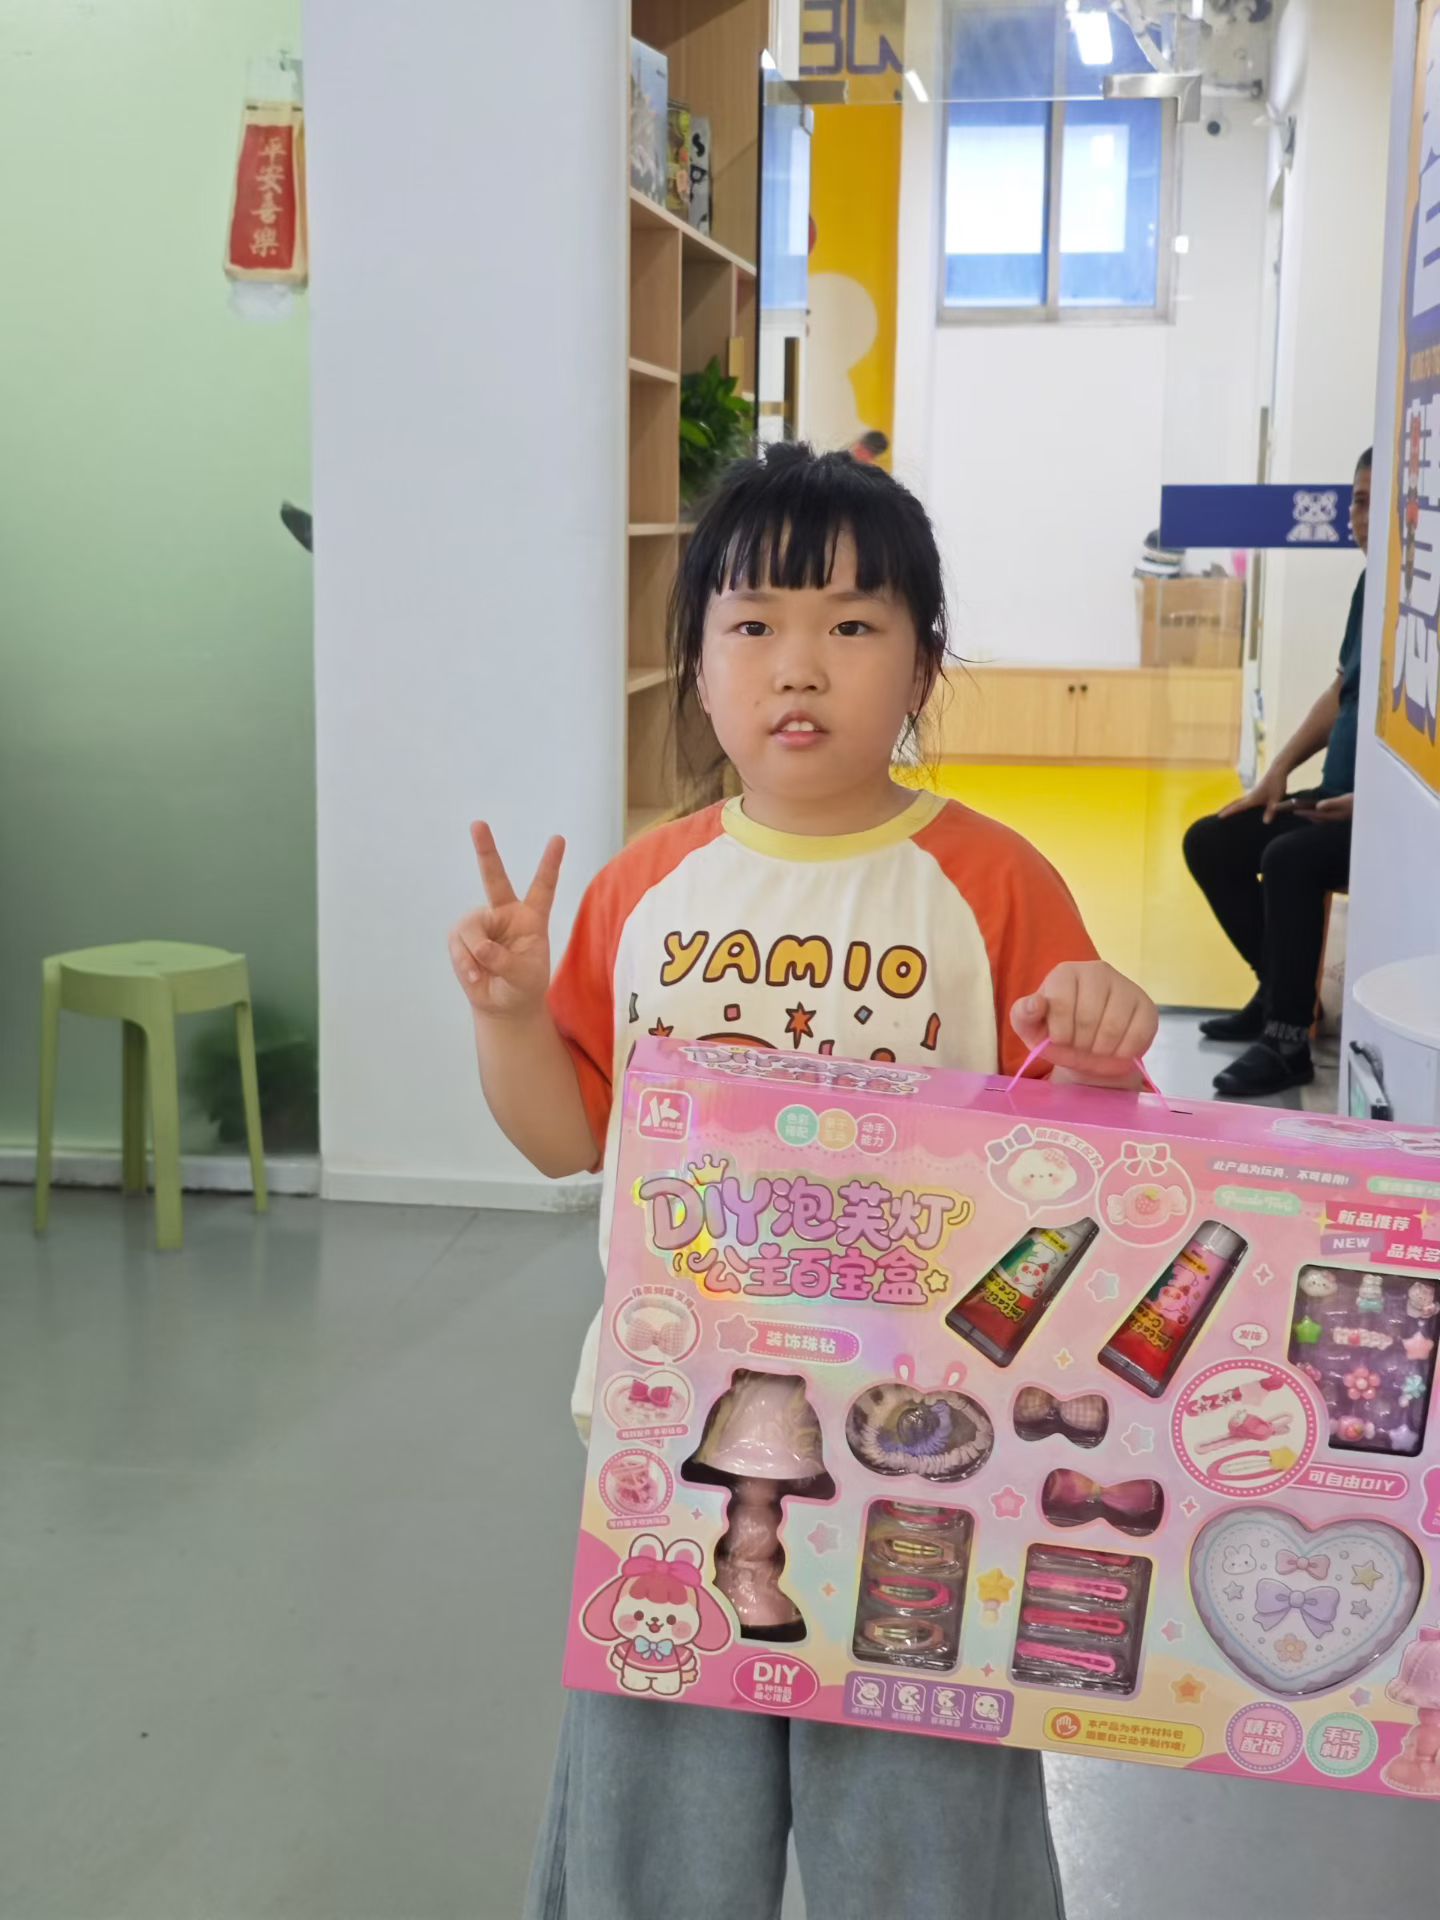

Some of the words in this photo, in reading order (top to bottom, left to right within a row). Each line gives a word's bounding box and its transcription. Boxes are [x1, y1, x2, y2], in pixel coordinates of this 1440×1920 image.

[660, 929, 927, 998] YAMIO
[639, 1176, 960, 1250] DIY泡芙灯
[1338, 1209, 1410, 1232] 新品推荐
[1332, 1237, 1370, 1249] NEW
[688, 1243, 928, 1305] 公主百宝盒
[1308, 1470, 1395, 1492] 可自由DIY
[753, 1661, 800, 1685] DIY
[1323, 1727, 1362, 1744] 手工
[1320, 1743, 1361, 1760] 制作
